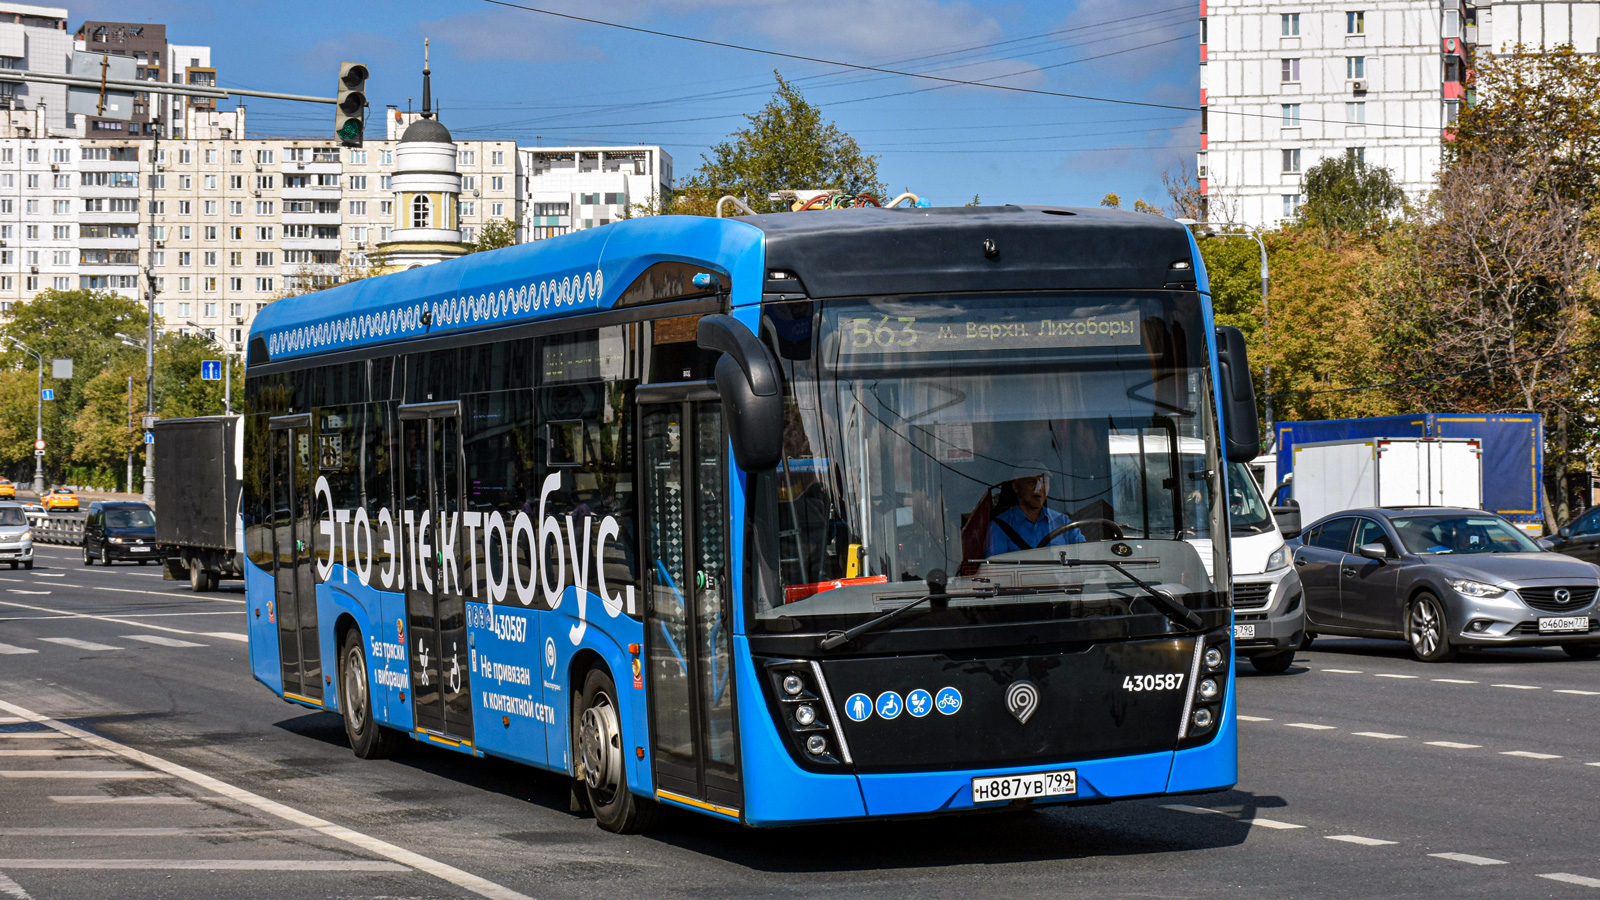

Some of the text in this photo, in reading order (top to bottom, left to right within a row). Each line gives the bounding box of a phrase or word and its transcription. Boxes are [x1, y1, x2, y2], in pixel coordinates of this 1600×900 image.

[852, 316, 1135, 348] 563 м. Верхн. Лихоборы
[314, 470, 635, 646] Это электробус.
[495, 615, 526, 642] 430587
[383, 643, 404, 663] тряски
[379, 665, 408, 691] вибраций
[481, 655, 530, 685] Не привязан
[1122, 673, 1185, 692] 430587
[489, 693, 534, 717] контактной
[536, 703, 554, 724] сети
[1046, 773, 1071, 788] 799
